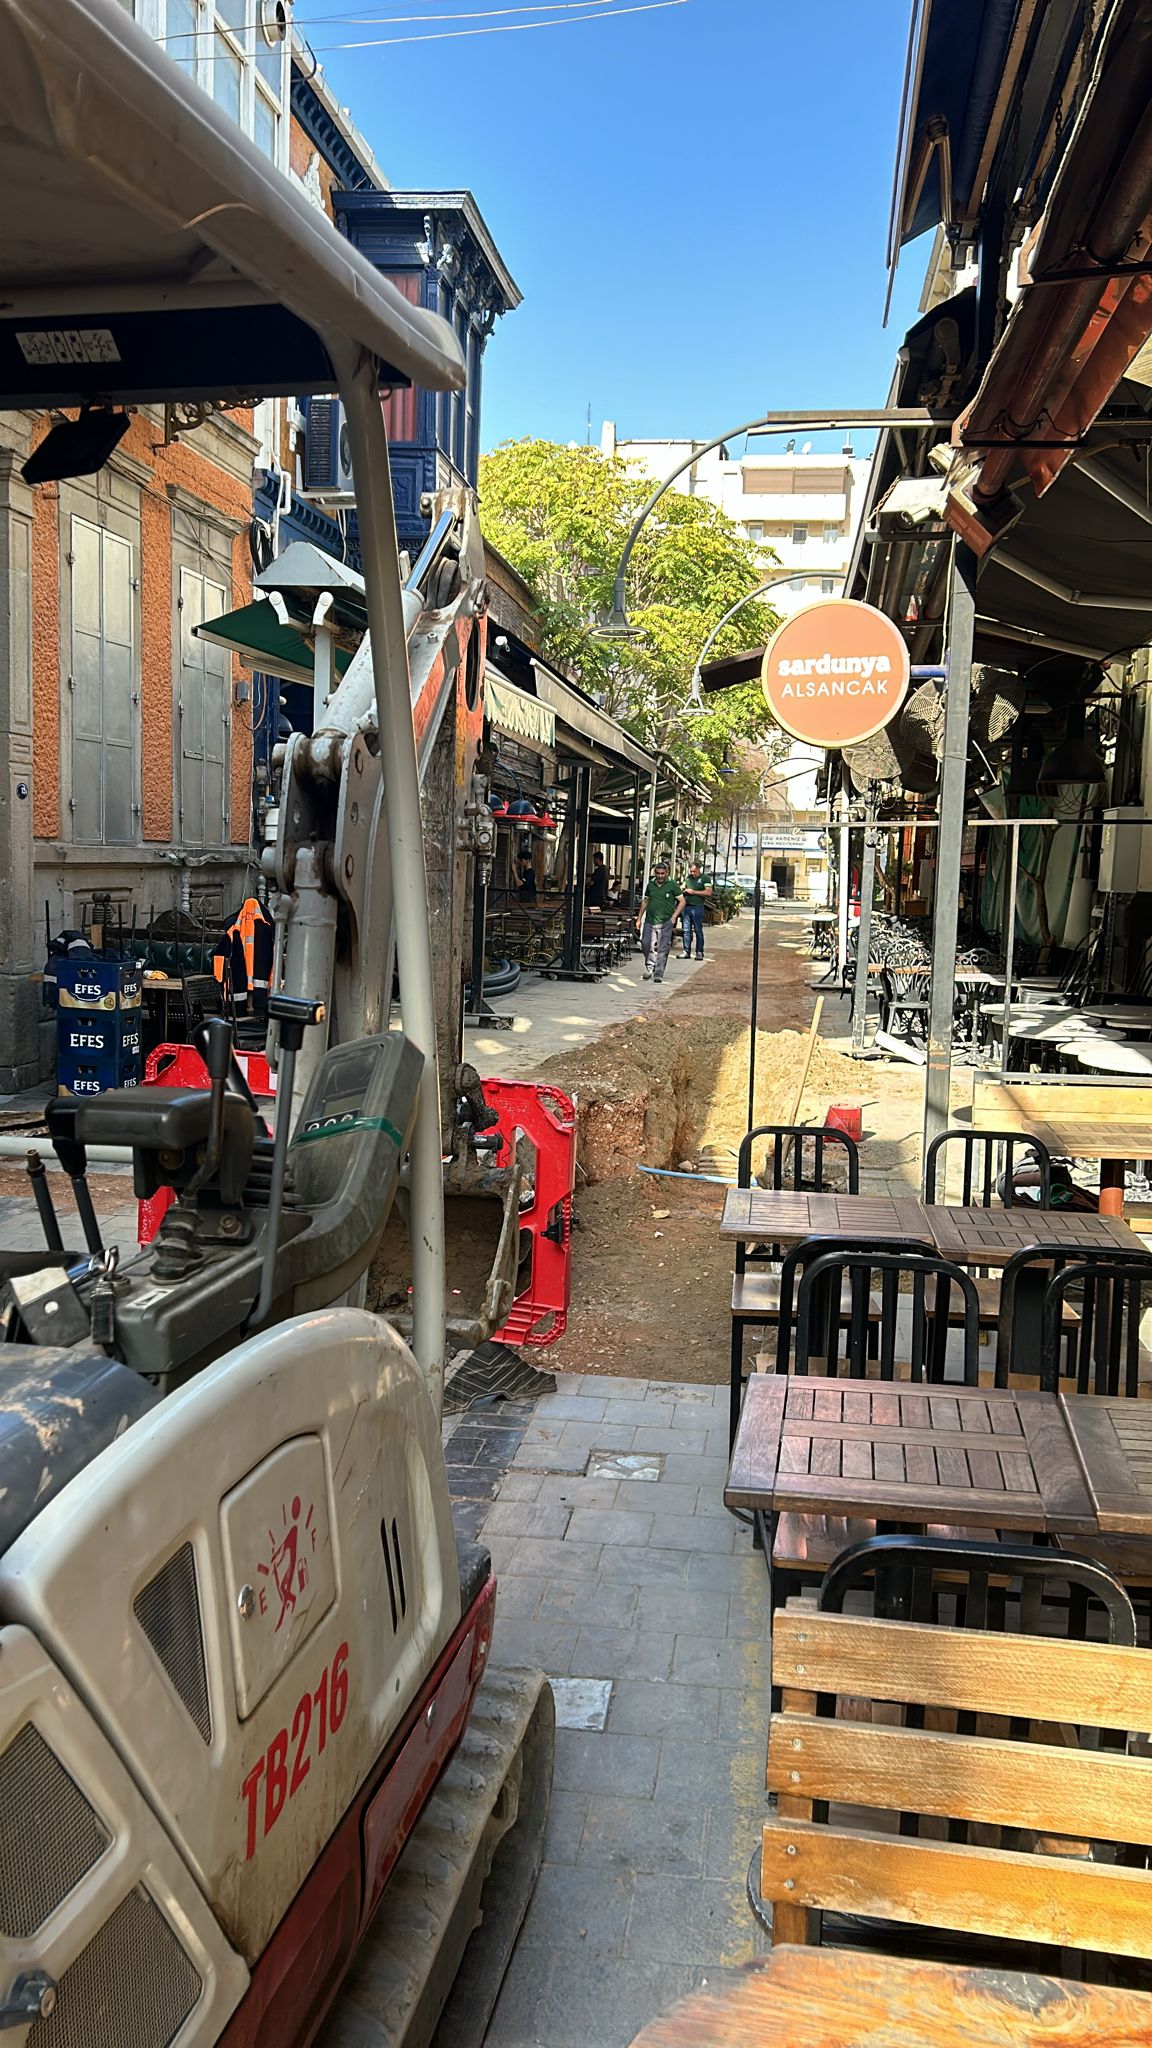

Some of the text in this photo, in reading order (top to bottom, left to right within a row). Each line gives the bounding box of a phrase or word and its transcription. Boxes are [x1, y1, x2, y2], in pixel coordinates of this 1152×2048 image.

[778, 653, 891, 678] sardunya
[781, 680, 888, 698] ALSANCAK
[74, 983, 102, 996] EFES
[123, 983, 137, 994] EFES
[70, 1033, 104, 1049] EFES
[122, 1033, 139, 1048] EFES
[73, 1080, 100, 1092] EFES
[124, 1078, 137, 1089] EFES
[241, 1641, 350, 1862] TB216
